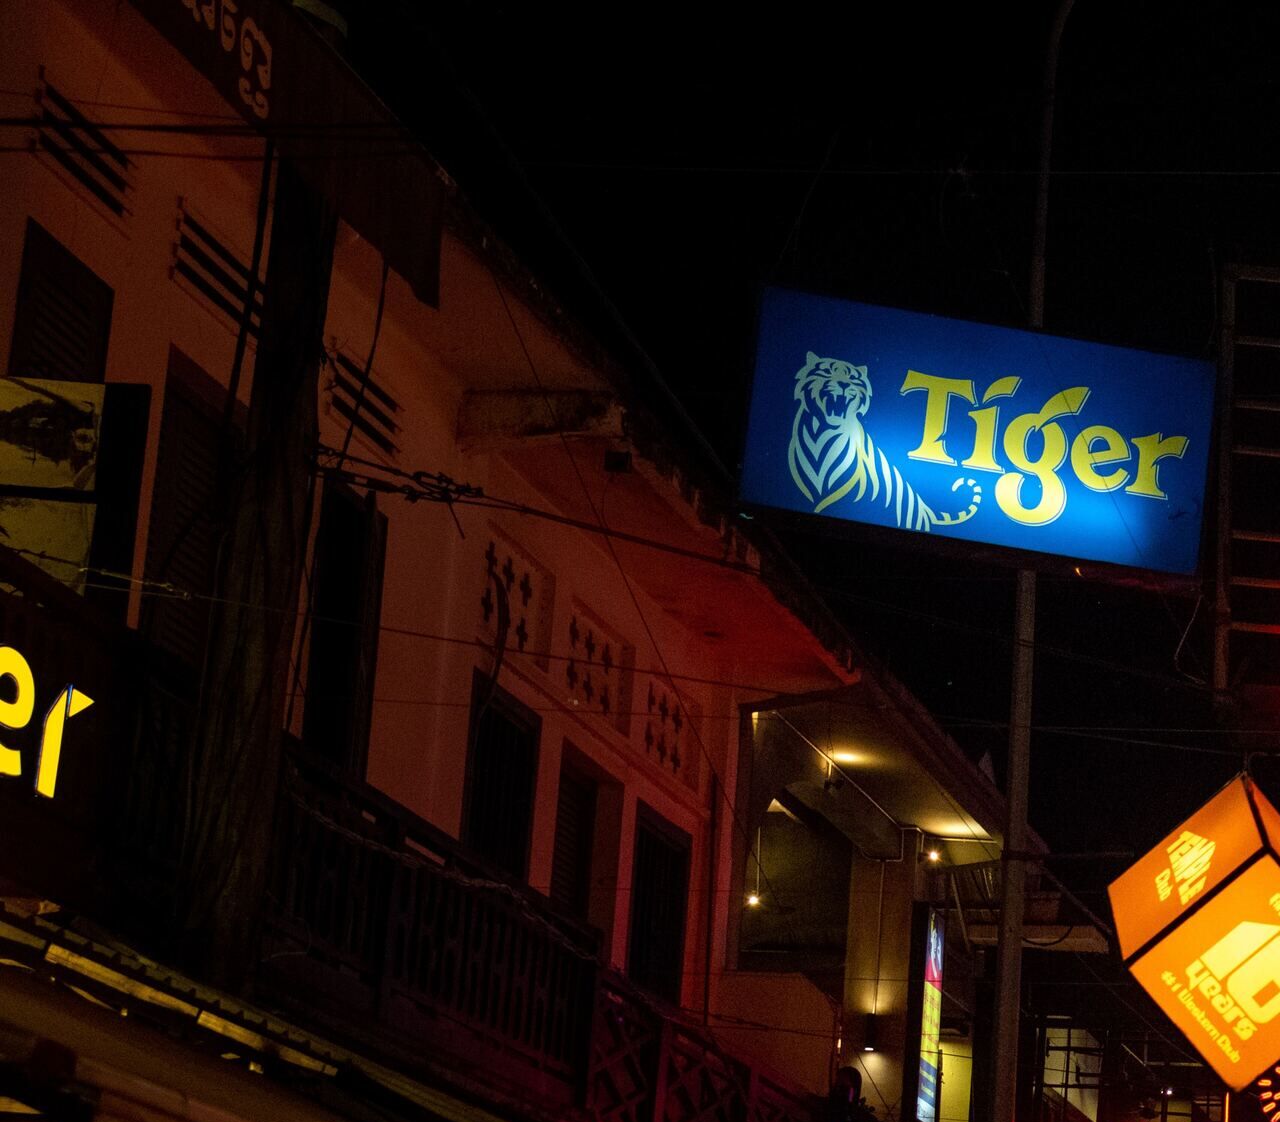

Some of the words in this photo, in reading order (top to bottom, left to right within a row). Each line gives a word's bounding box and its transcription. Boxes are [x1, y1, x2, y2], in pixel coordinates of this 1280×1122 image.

[900, 369, 1189, 527] Tiger
[1167, 830, 1216, 906] TEMPLE
[1185, 959, 1258, 1041] years
